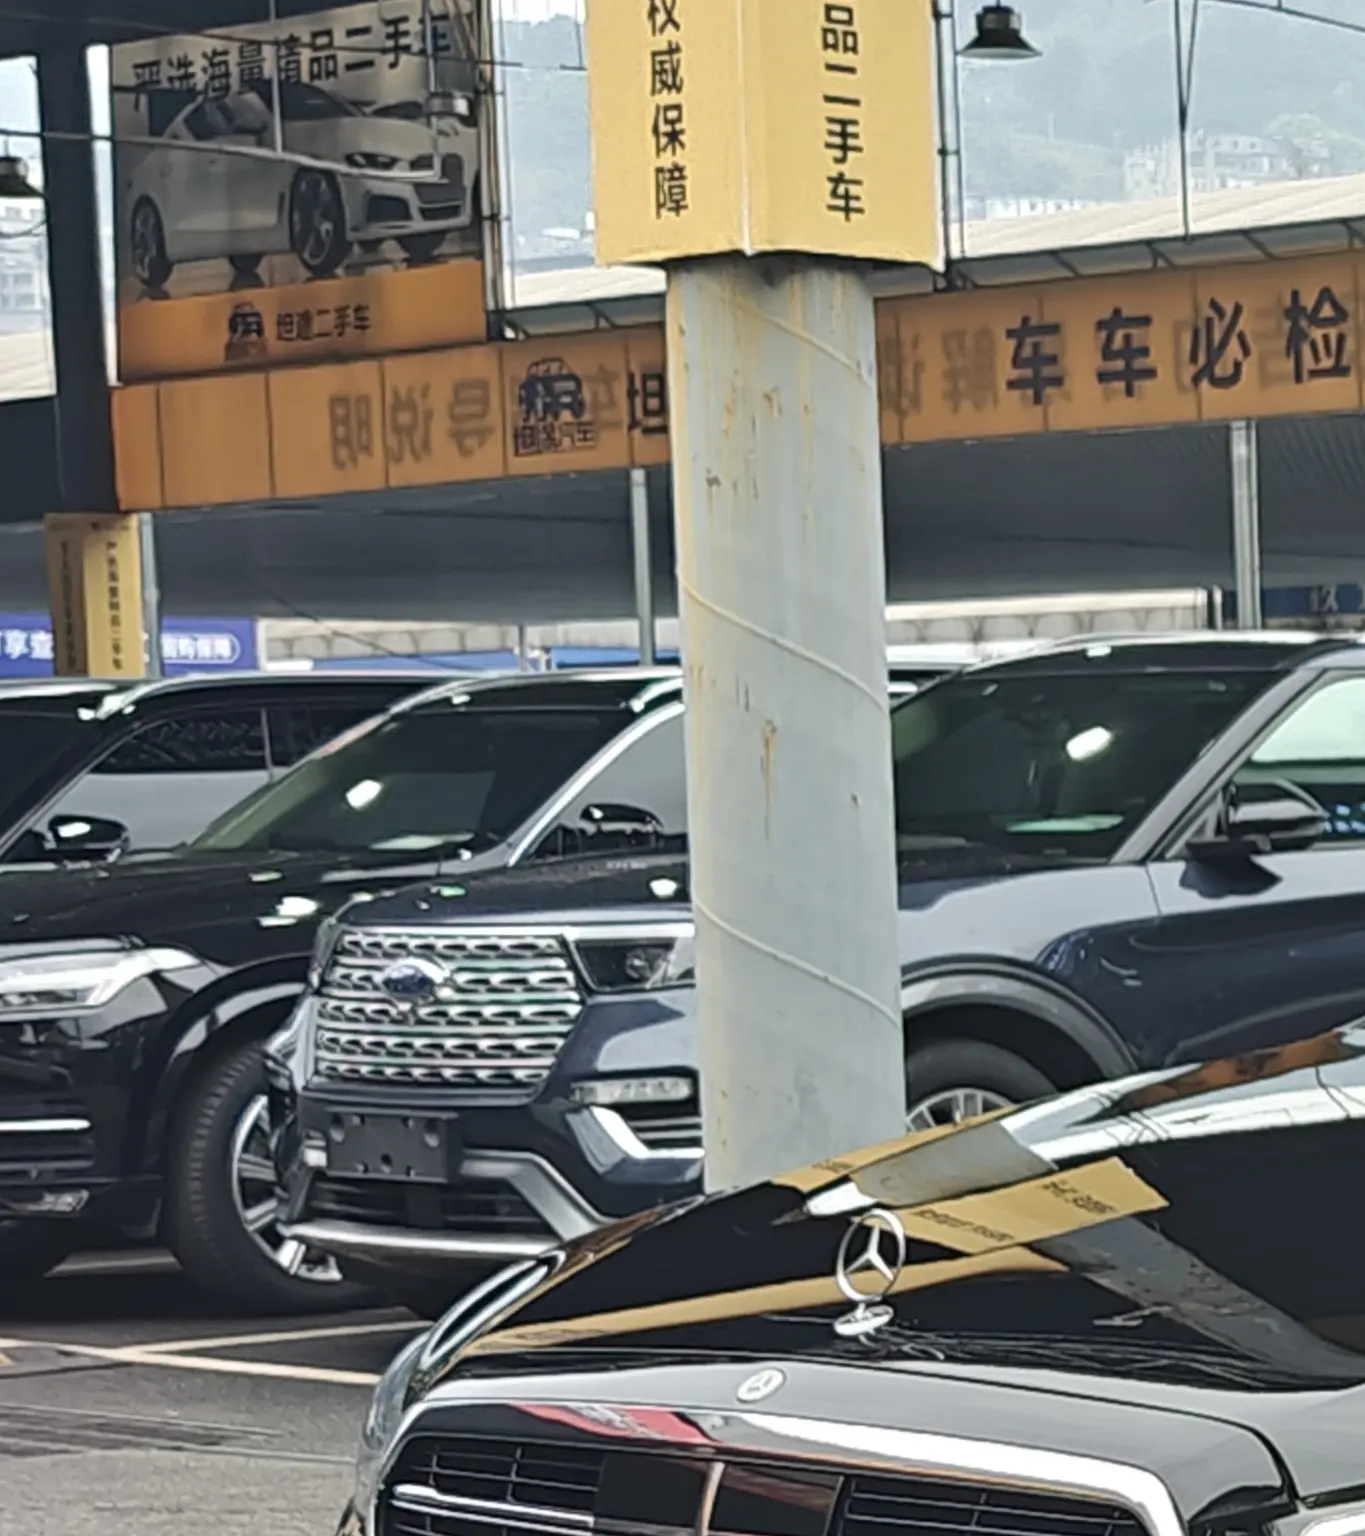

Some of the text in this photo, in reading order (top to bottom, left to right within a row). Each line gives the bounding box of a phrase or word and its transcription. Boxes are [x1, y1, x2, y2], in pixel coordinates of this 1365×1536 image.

[820, 3, 866, 222] 品二手车
[1005, 286, 1351, 405] 车车必检
